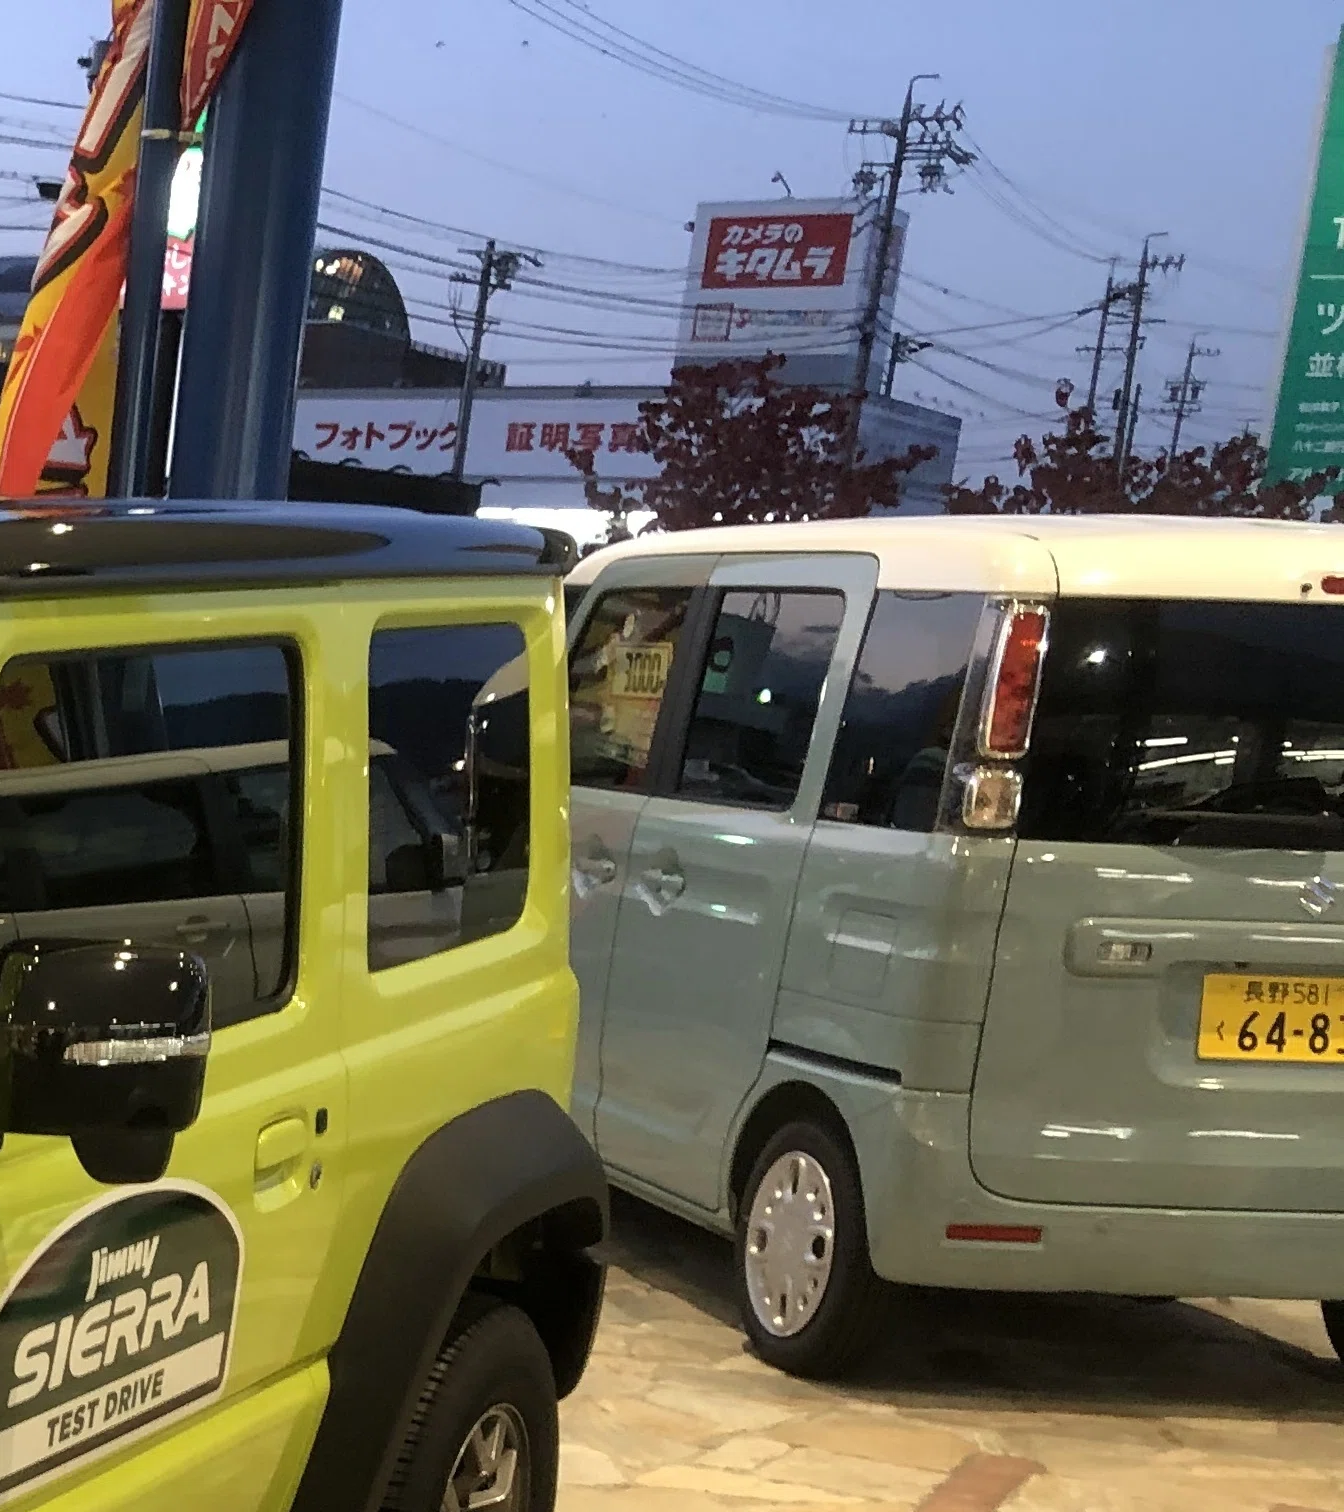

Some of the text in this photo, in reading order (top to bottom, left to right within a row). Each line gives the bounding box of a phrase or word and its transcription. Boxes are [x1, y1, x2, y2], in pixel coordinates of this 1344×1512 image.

[721, 223, 804, 246] カメラの
[714, 247, 836, 282] キタムラ
[315, 420, 458, 451] フォトブック
[85, 1235, 160, 1302] Jimny
[7, 1261, 210, 1409] SIERRA
[47, 1368, 165, 1448] TEST DRIVE
